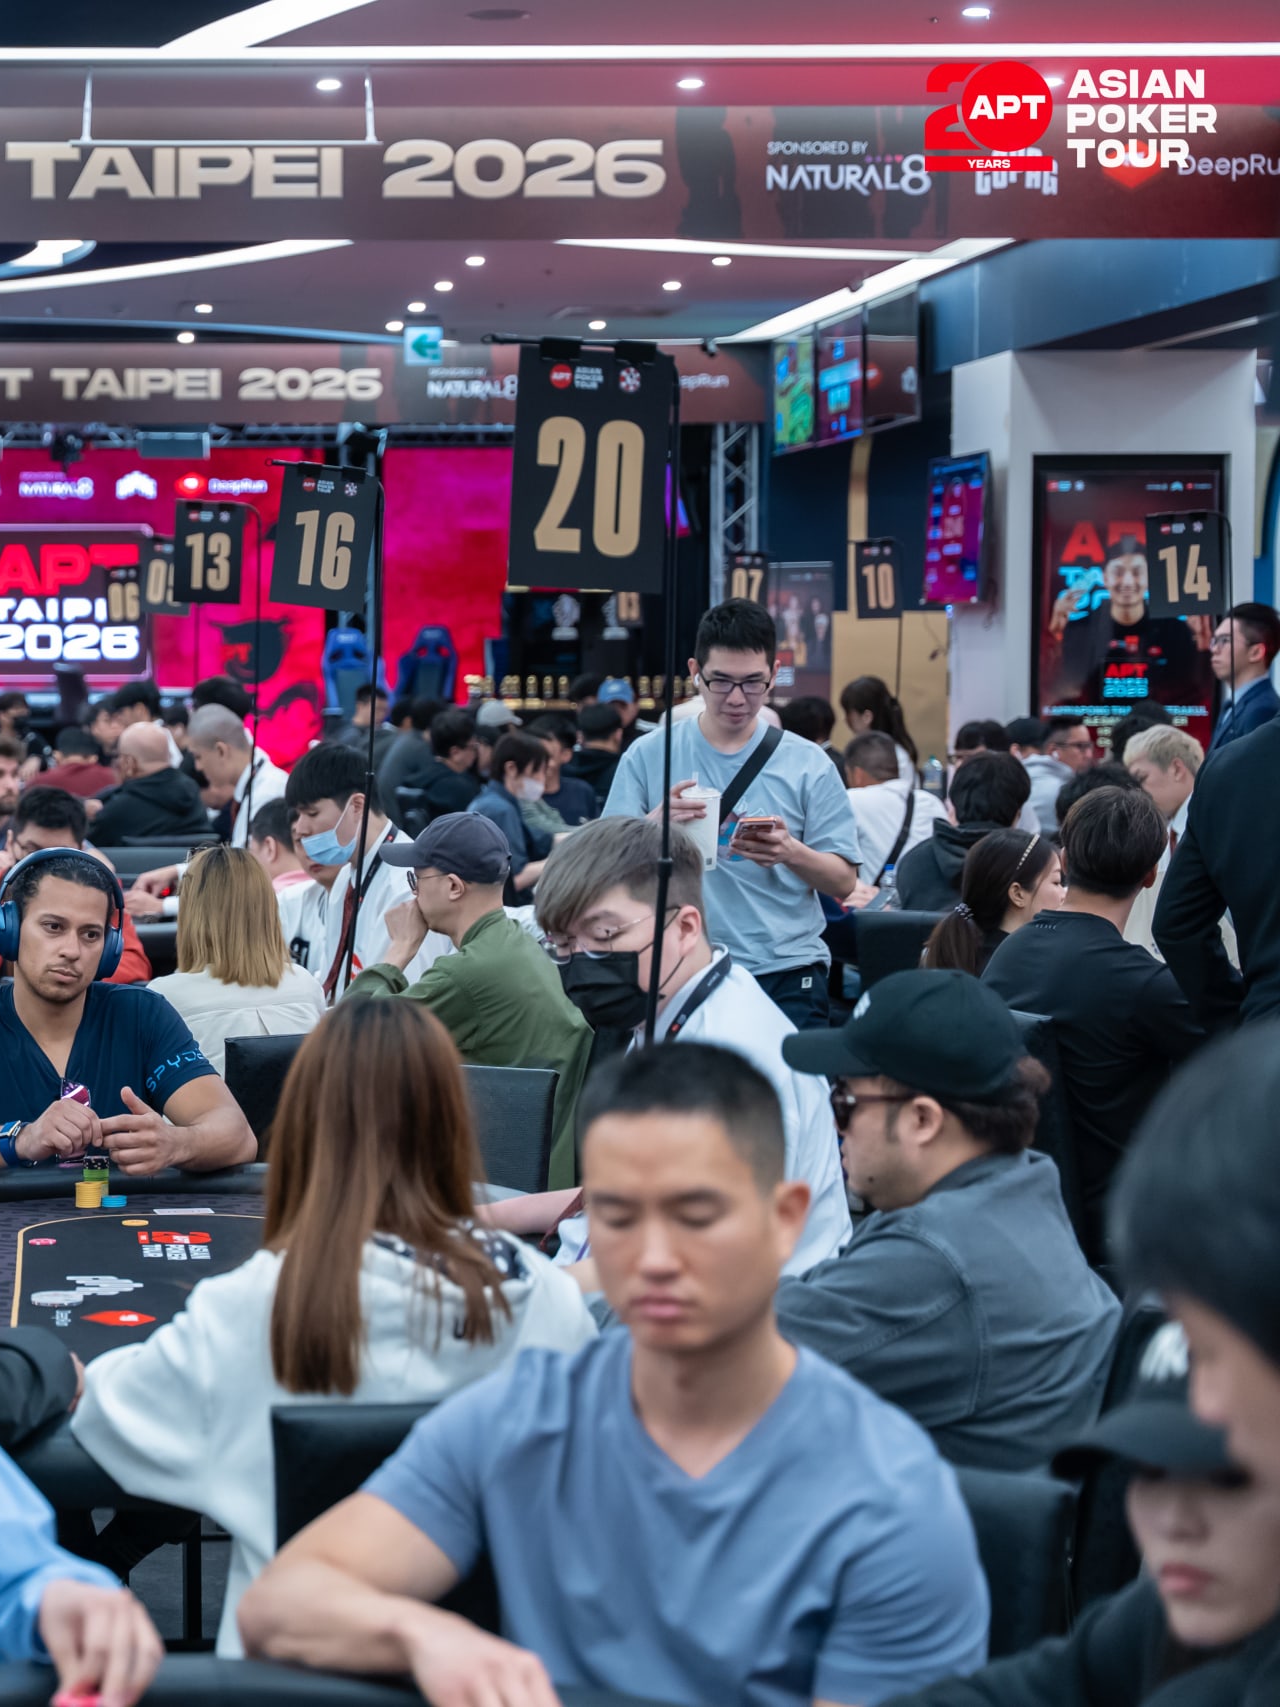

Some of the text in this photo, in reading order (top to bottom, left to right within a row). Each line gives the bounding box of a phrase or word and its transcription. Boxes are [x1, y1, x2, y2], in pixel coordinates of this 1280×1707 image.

[5, 141, 343, 199] TAIPEI
[382, 139, 668, 199] 2026
[767, 141, 869, 156] SPONSORED BY
[766, 154, 932, 196] NATURAL8
[50, 367, 222, 400] TAIPEI
[238, 367, 384, 400] 2026
[534, 416, 645, 558] 20
[185, 532, 231, 591] 13
[295, 510, 355, 590] 16
[731, 568, 764, 602] 07
[862, 563, 895, 610] 10
[1158, 544, 1211, 602] 14
[108, 582, 140, 622] 06
[1104, 663, 1148, 678] APT
